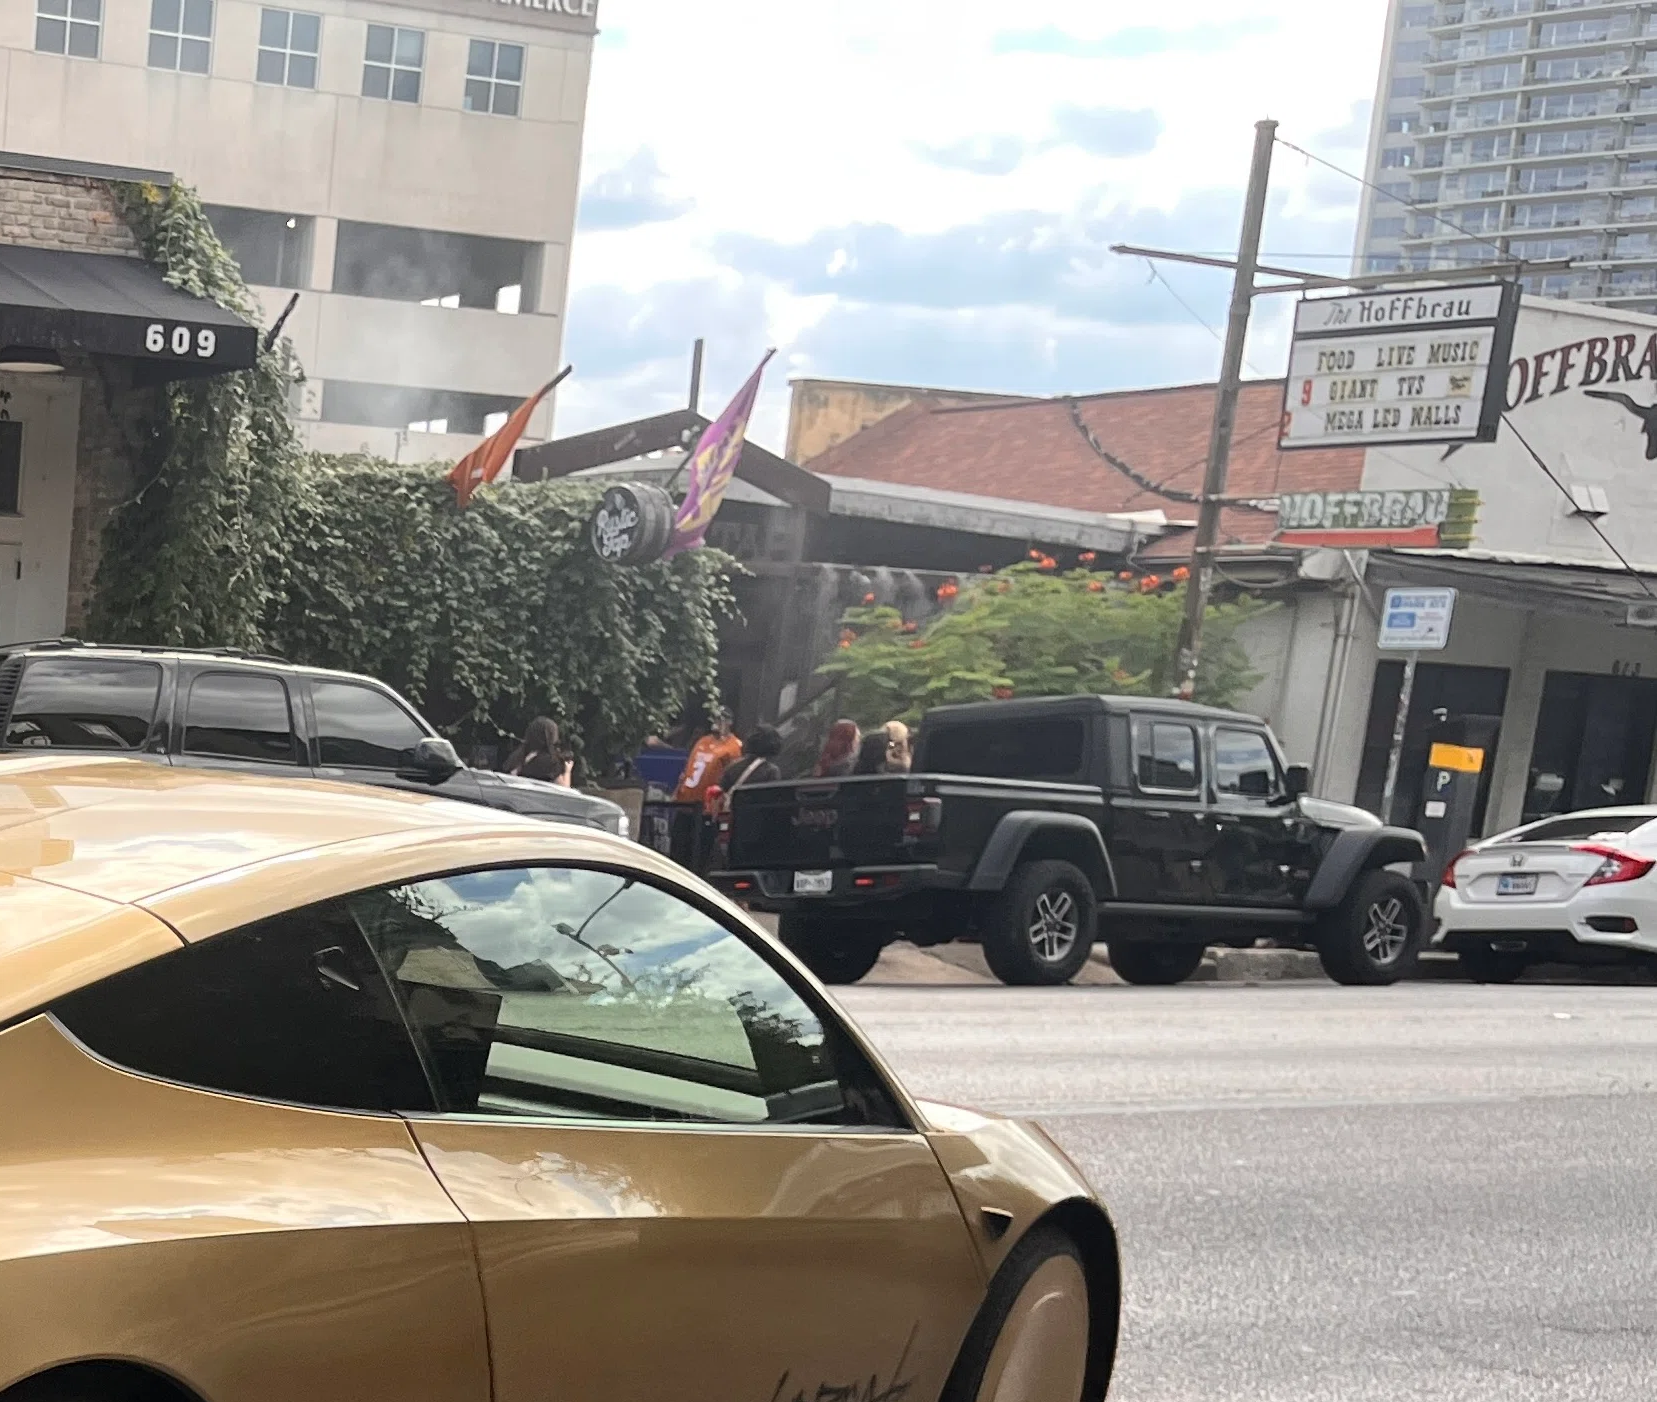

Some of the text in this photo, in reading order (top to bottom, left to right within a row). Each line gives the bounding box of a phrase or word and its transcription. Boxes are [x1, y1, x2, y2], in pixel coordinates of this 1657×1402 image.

[145, 323, 217, 358] 609
[1317, 340, 1479, 372] FOOD LIVE MUSIC
[1301, 378, 1313, 406] 9
[1324, 409, 1364, 431] MEGA
[1373, 407, 1401, 429] LED
[1280, 490, 1451, 529] HOFFBRAU
